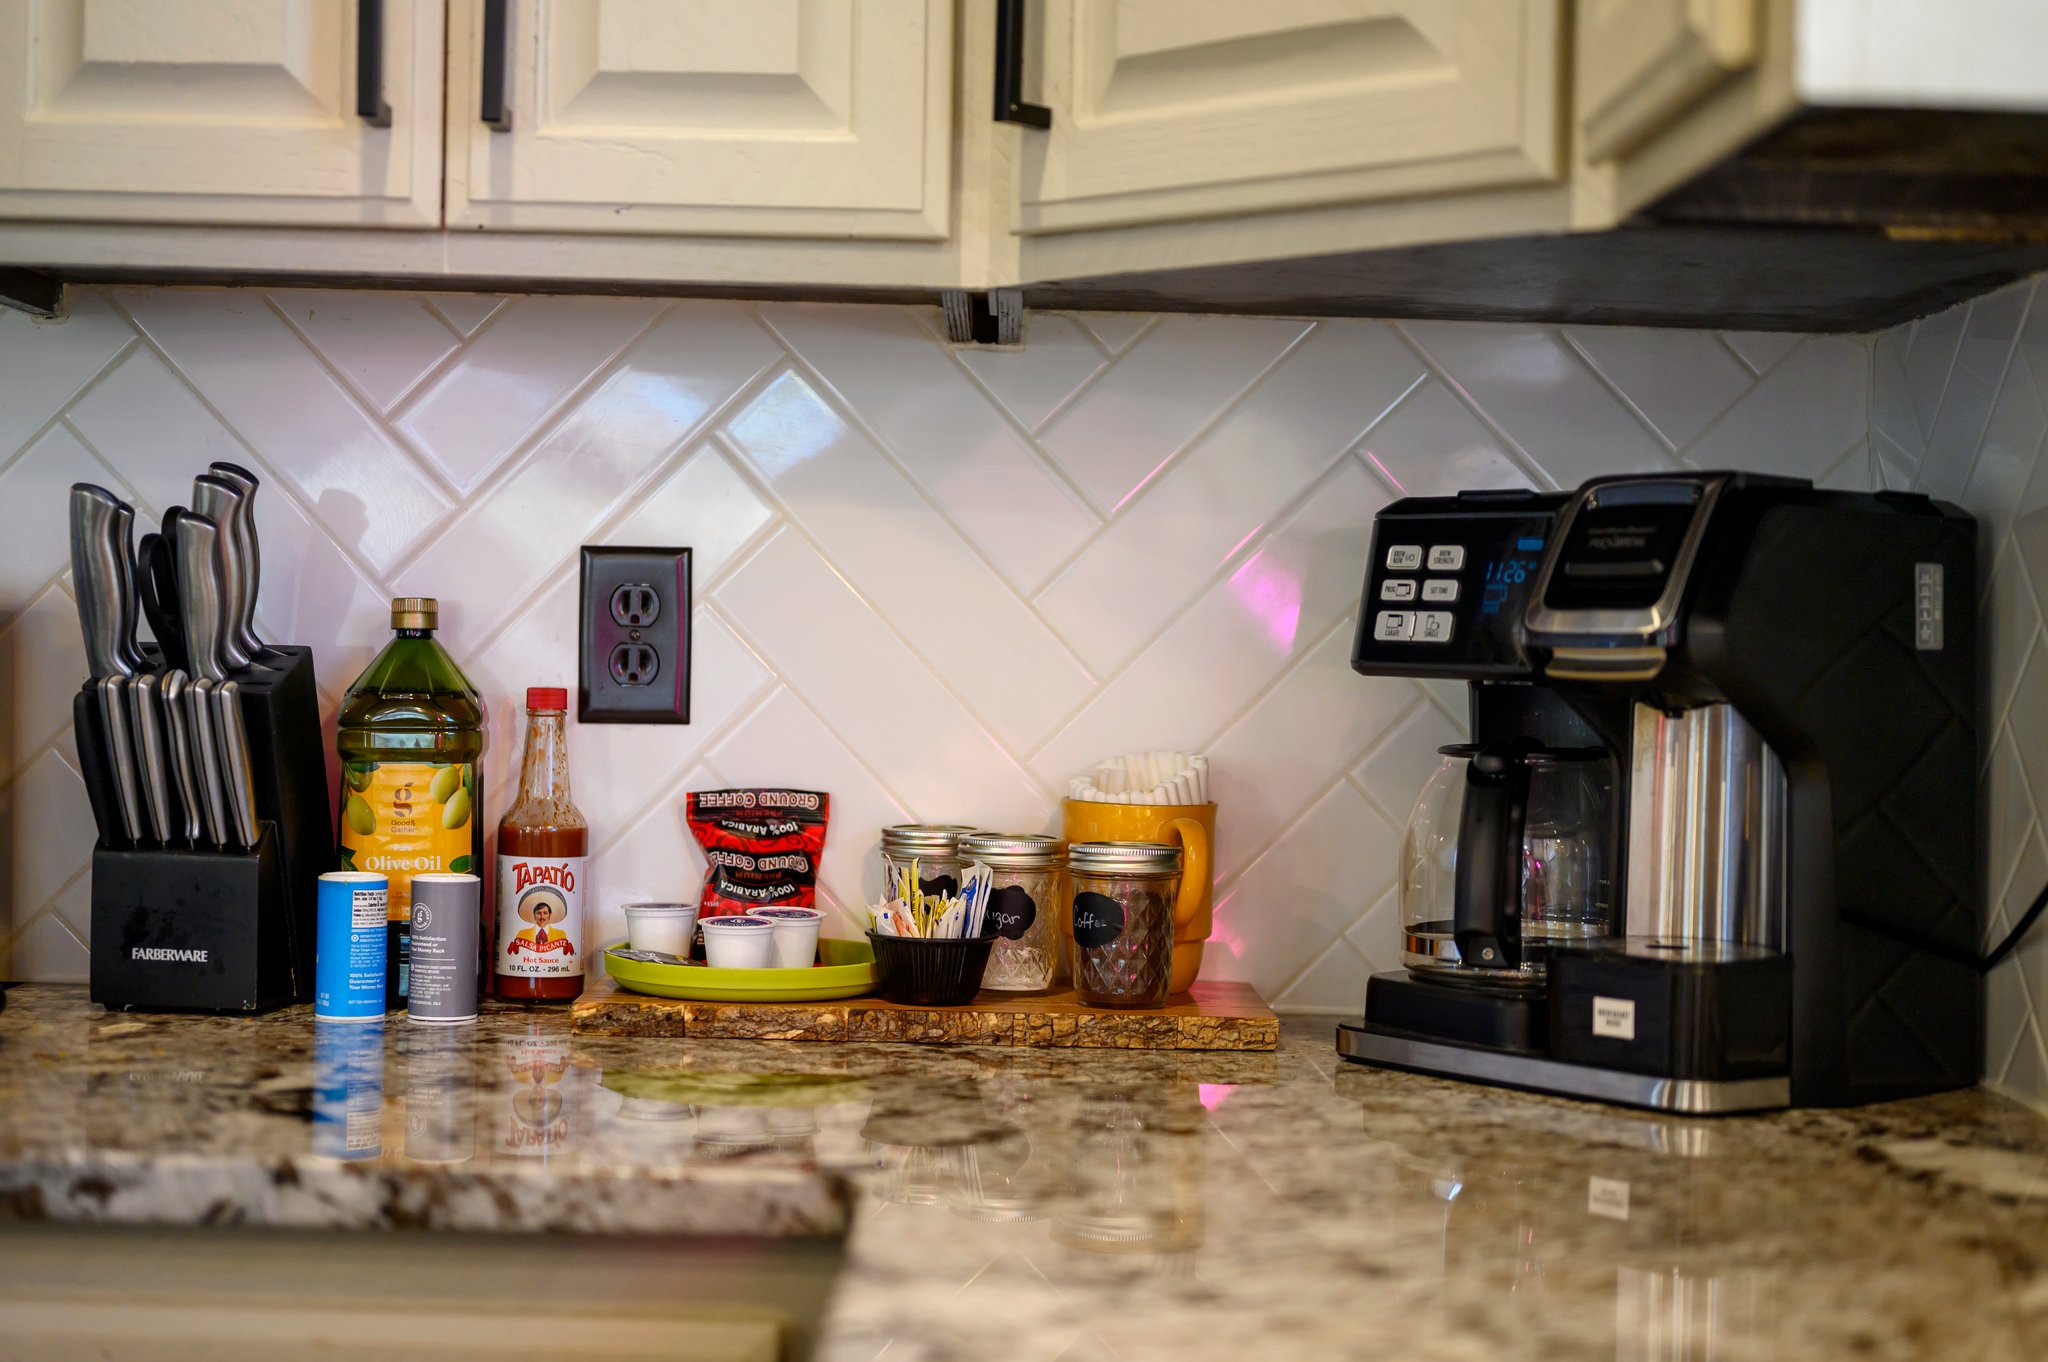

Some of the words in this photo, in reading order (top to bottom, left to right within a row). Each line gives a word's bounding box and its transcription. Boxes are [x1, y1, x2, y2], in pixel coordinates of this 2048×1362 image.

[699, 793, 756, 808] COFFEE
[759, 792, 819, 810] GROUND
[721, 819, 767, 835] ARABICA
[769, 821, 798, 835] 100%
[365, 856, 411, 871] Olive
[414, 856, 442, 870] Oil
[720, 880, 767, 898] ARABICA
[768, 883, 795, 898] 100%
[986, 910, 1021, 930] ugar
[515, 938, 537, 951] SALSA
[539, 939, 568, 952] PICANTE
[131, 947, 208, 963] FARBERWARE
[523, 956, 537, 964] Hot
